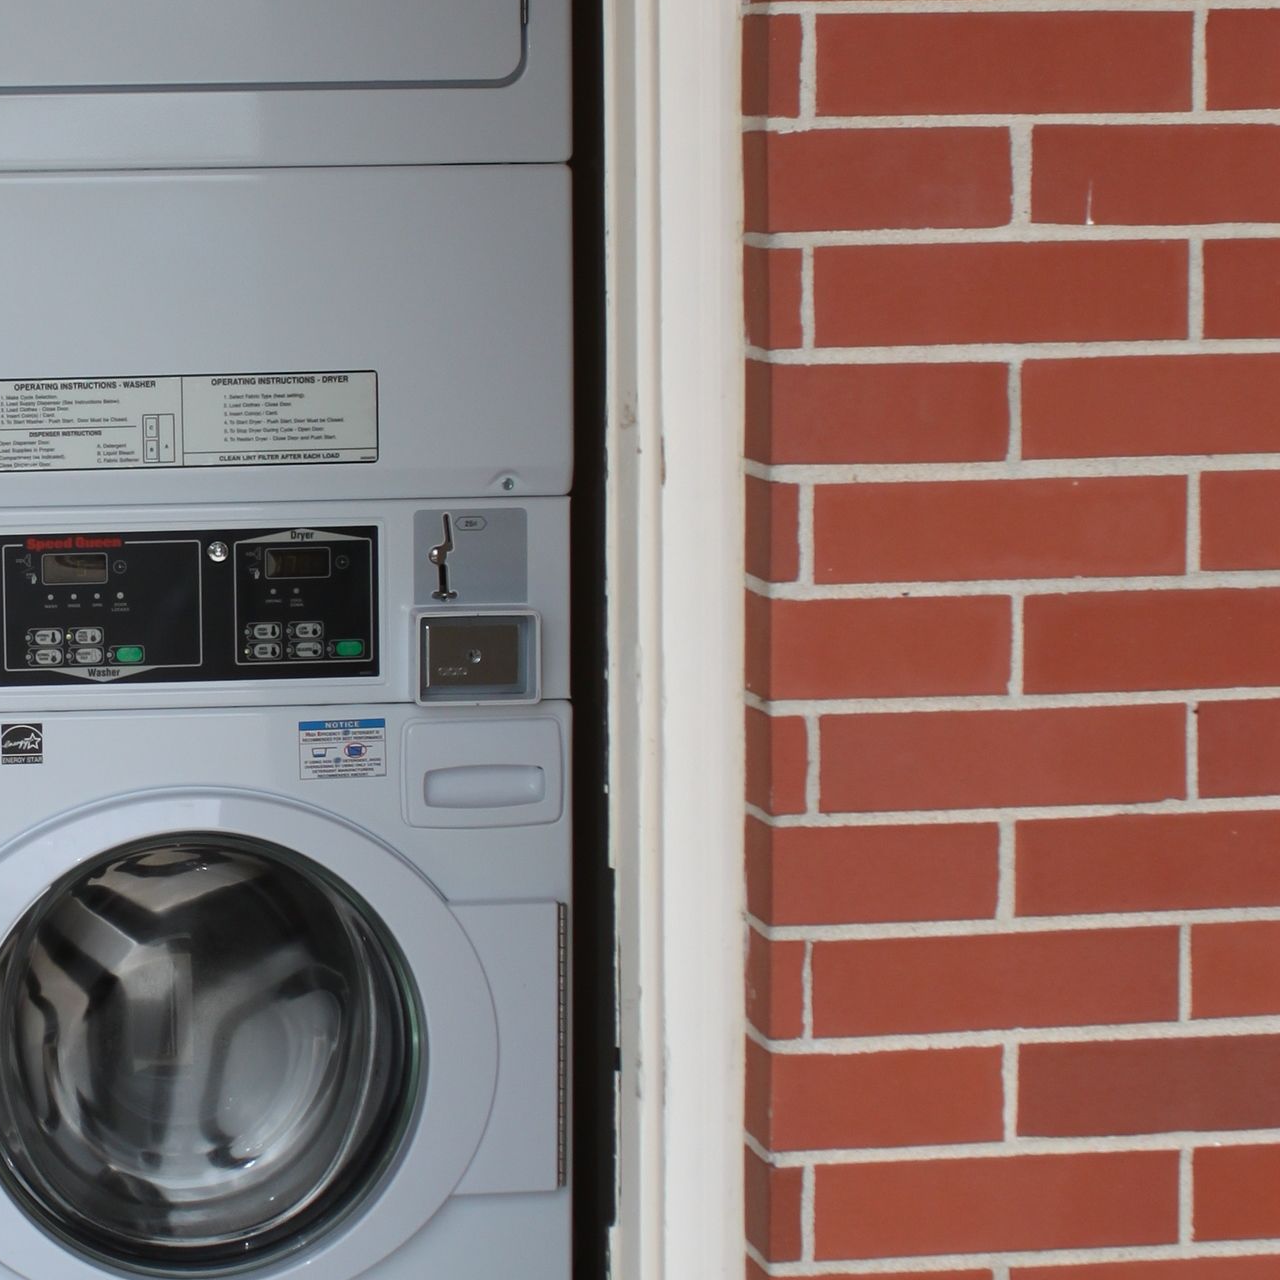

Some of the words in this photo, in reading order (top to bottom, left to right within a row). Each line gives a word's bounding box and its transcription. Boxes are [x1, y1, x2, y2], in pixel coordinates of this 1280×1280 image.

[211, 378, 256, 386] OPERATING
[258, 376, 315, 384] INSTRUCTIONS
[14, 383, 58, 391] OPERATING
[61, 382, 117, 390] INSTRUCTIONS
[291, 531, 314, 540] Dryer
[27, 538, 72, 551] Speed
[76, 537, 121, 547] Queen
[88, 669, 121, 677] Washer
